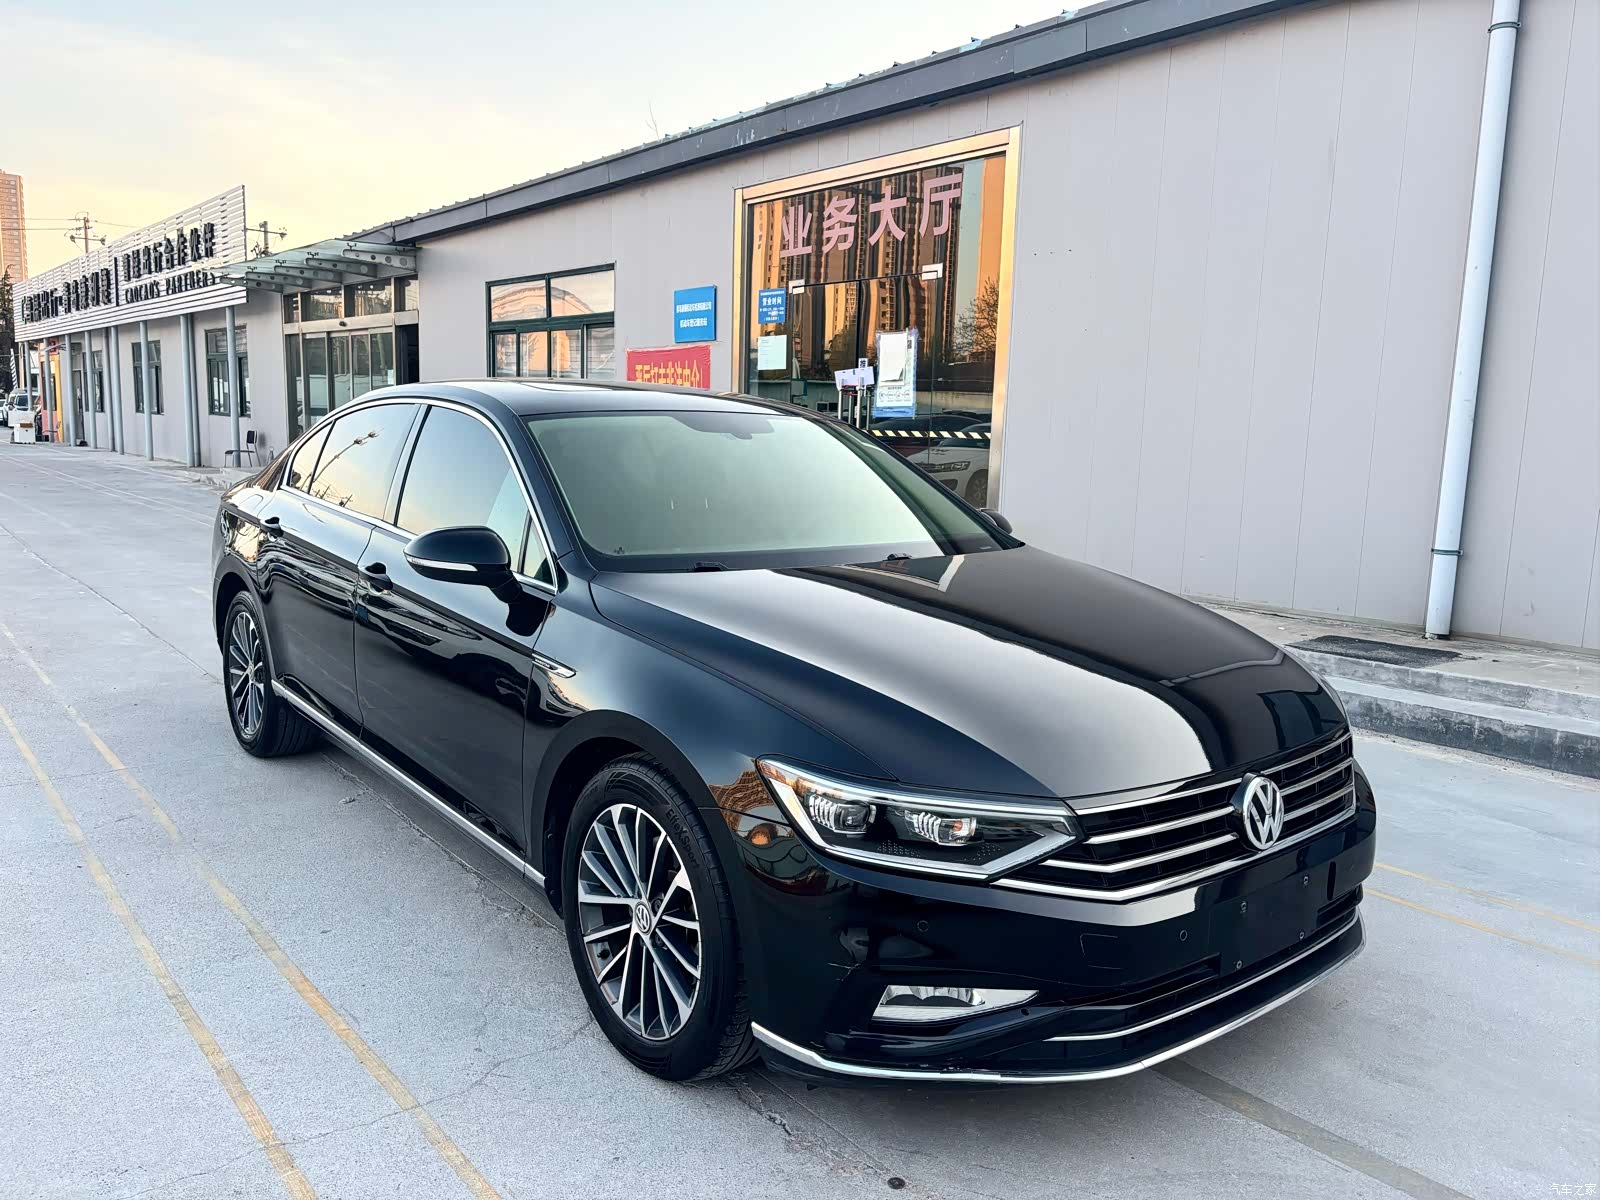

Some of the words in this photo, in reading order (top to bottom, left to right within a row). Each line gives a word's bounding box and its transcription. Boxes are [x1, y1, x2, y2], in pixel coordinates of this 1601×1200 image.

[780, 173, 962, 258] 业务大厅
[762, 296, 782, 306] 营业时间
